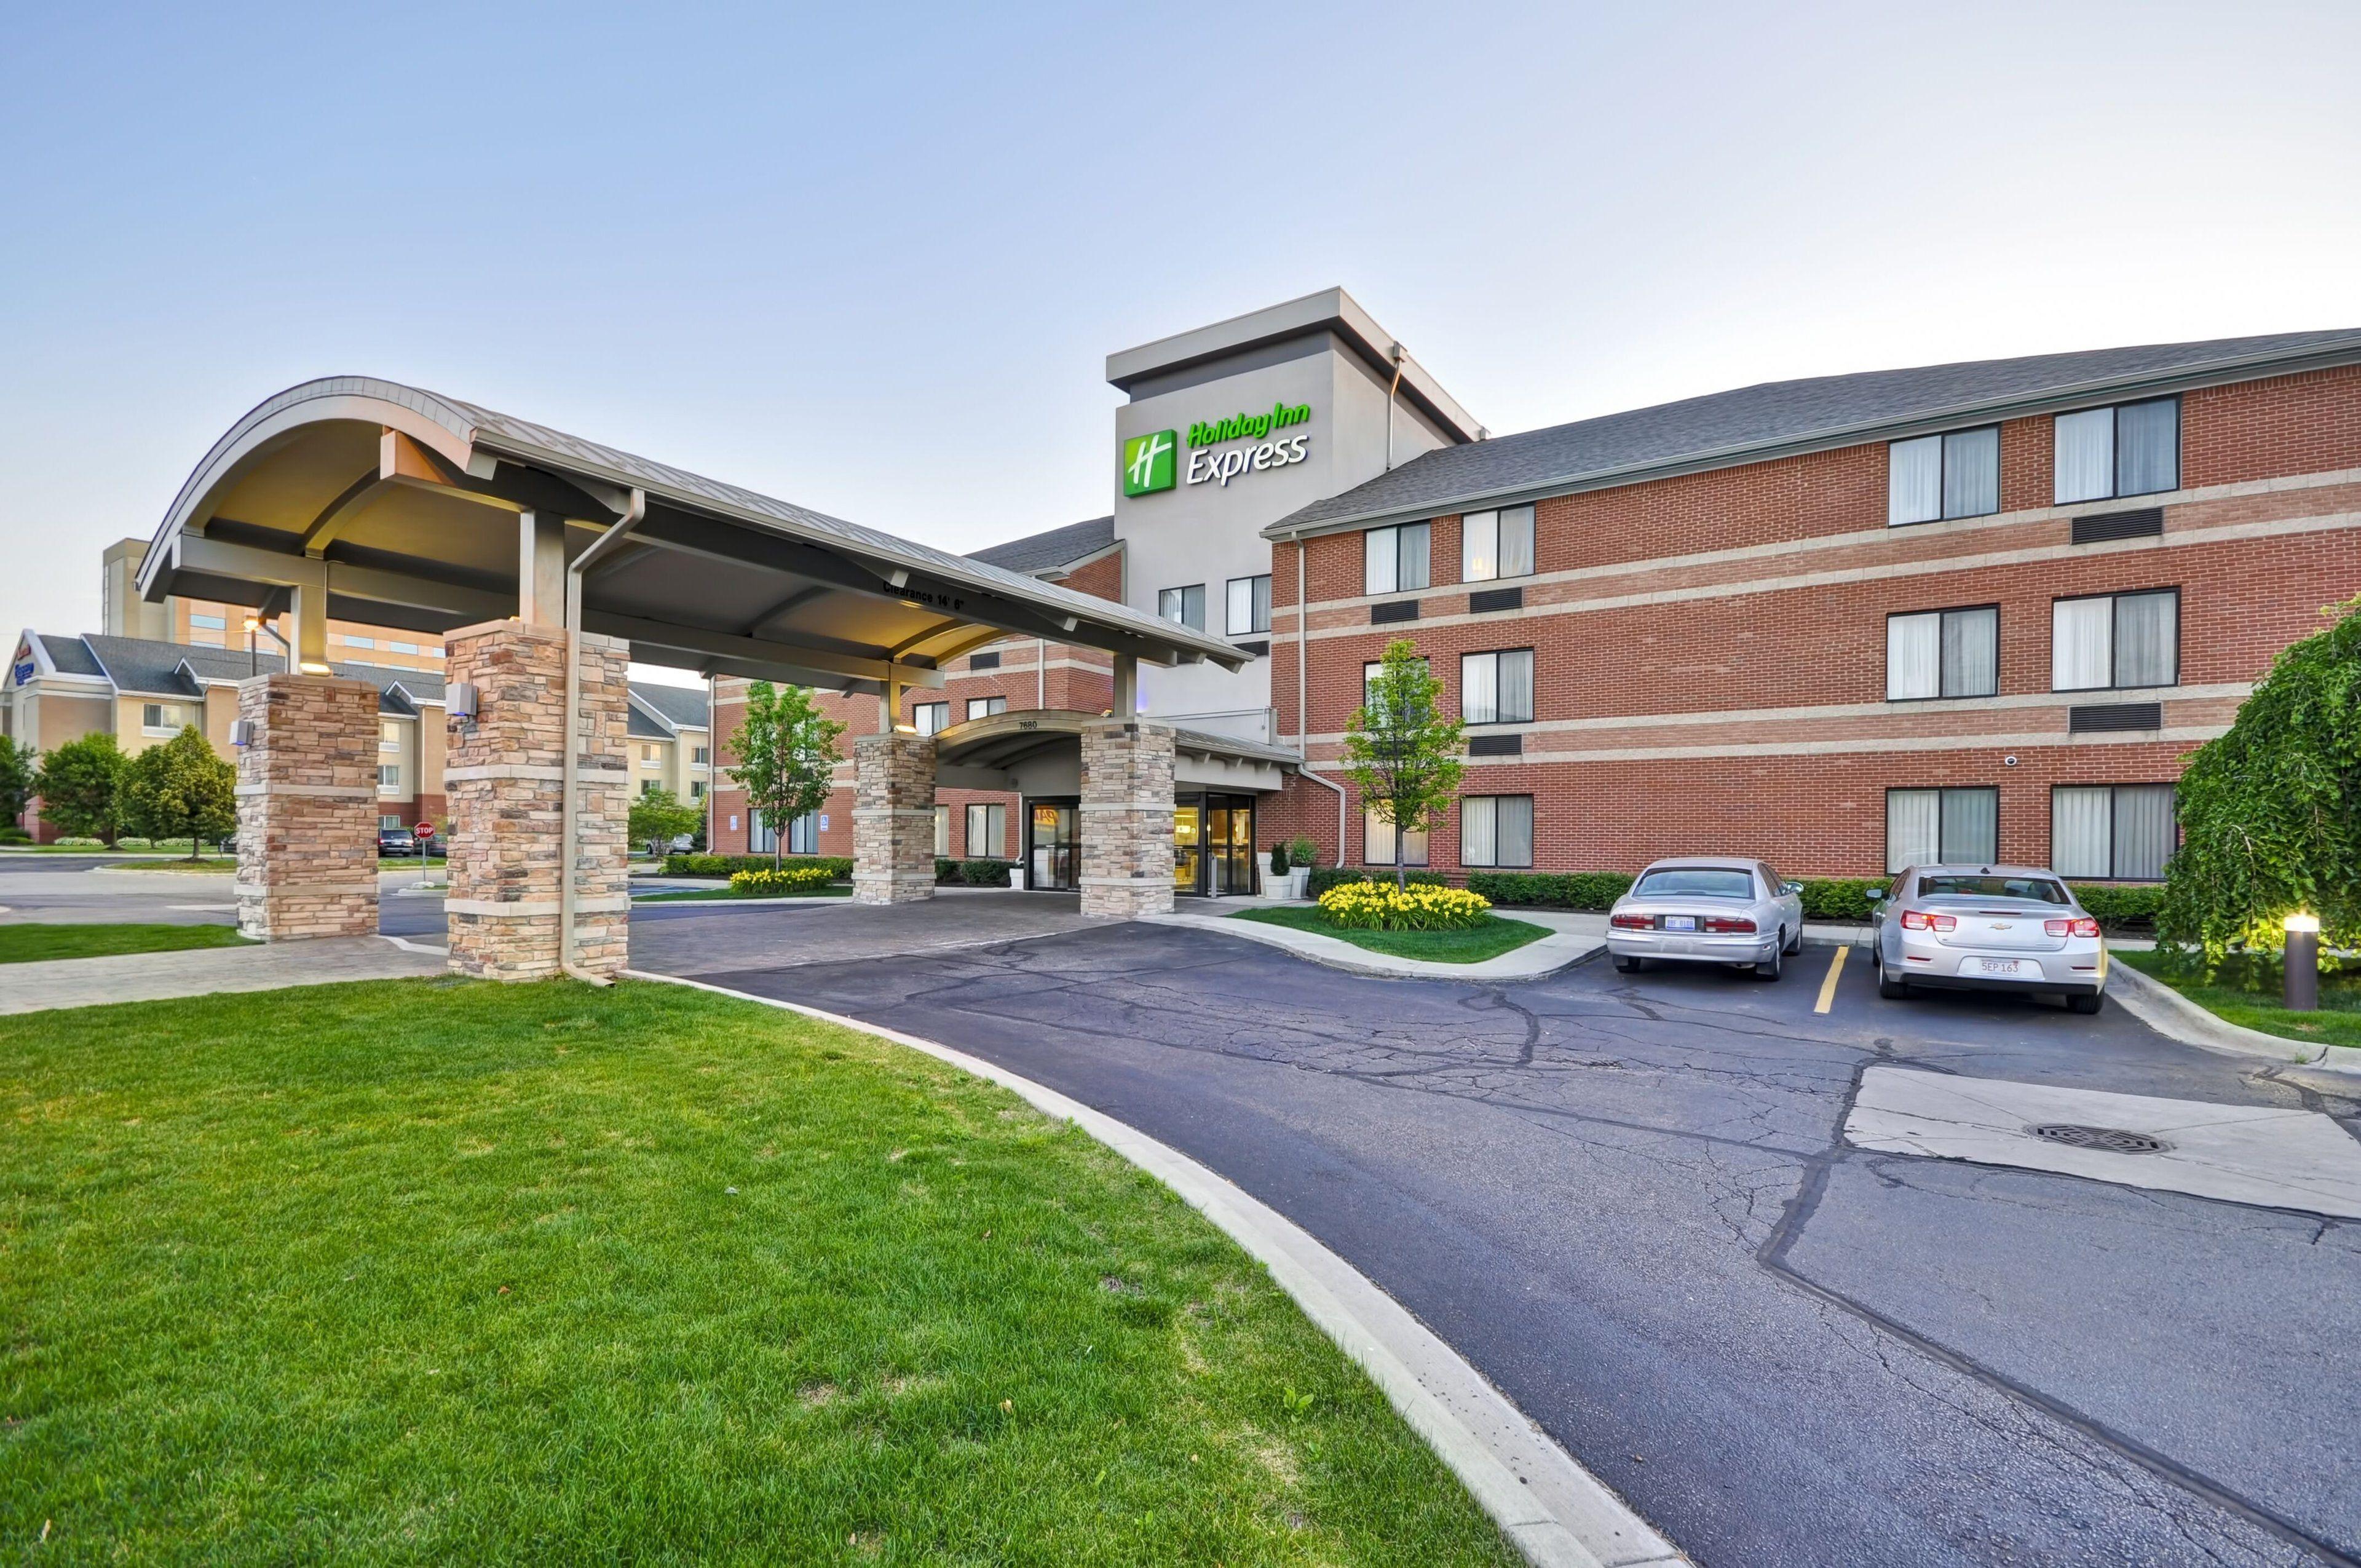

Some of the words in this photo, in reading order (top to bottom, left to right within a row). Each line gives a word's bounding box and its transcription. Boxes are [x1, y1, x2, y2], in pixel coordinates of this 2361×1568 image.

[1187, 413, 1272, 448] Holiday
[1271, 402, 1311, 429] Inn
[1186, 434, 1308, 486] Express
[883, 580, 933, 603] Clearance
[2001, 964, 2019, 973] 163
